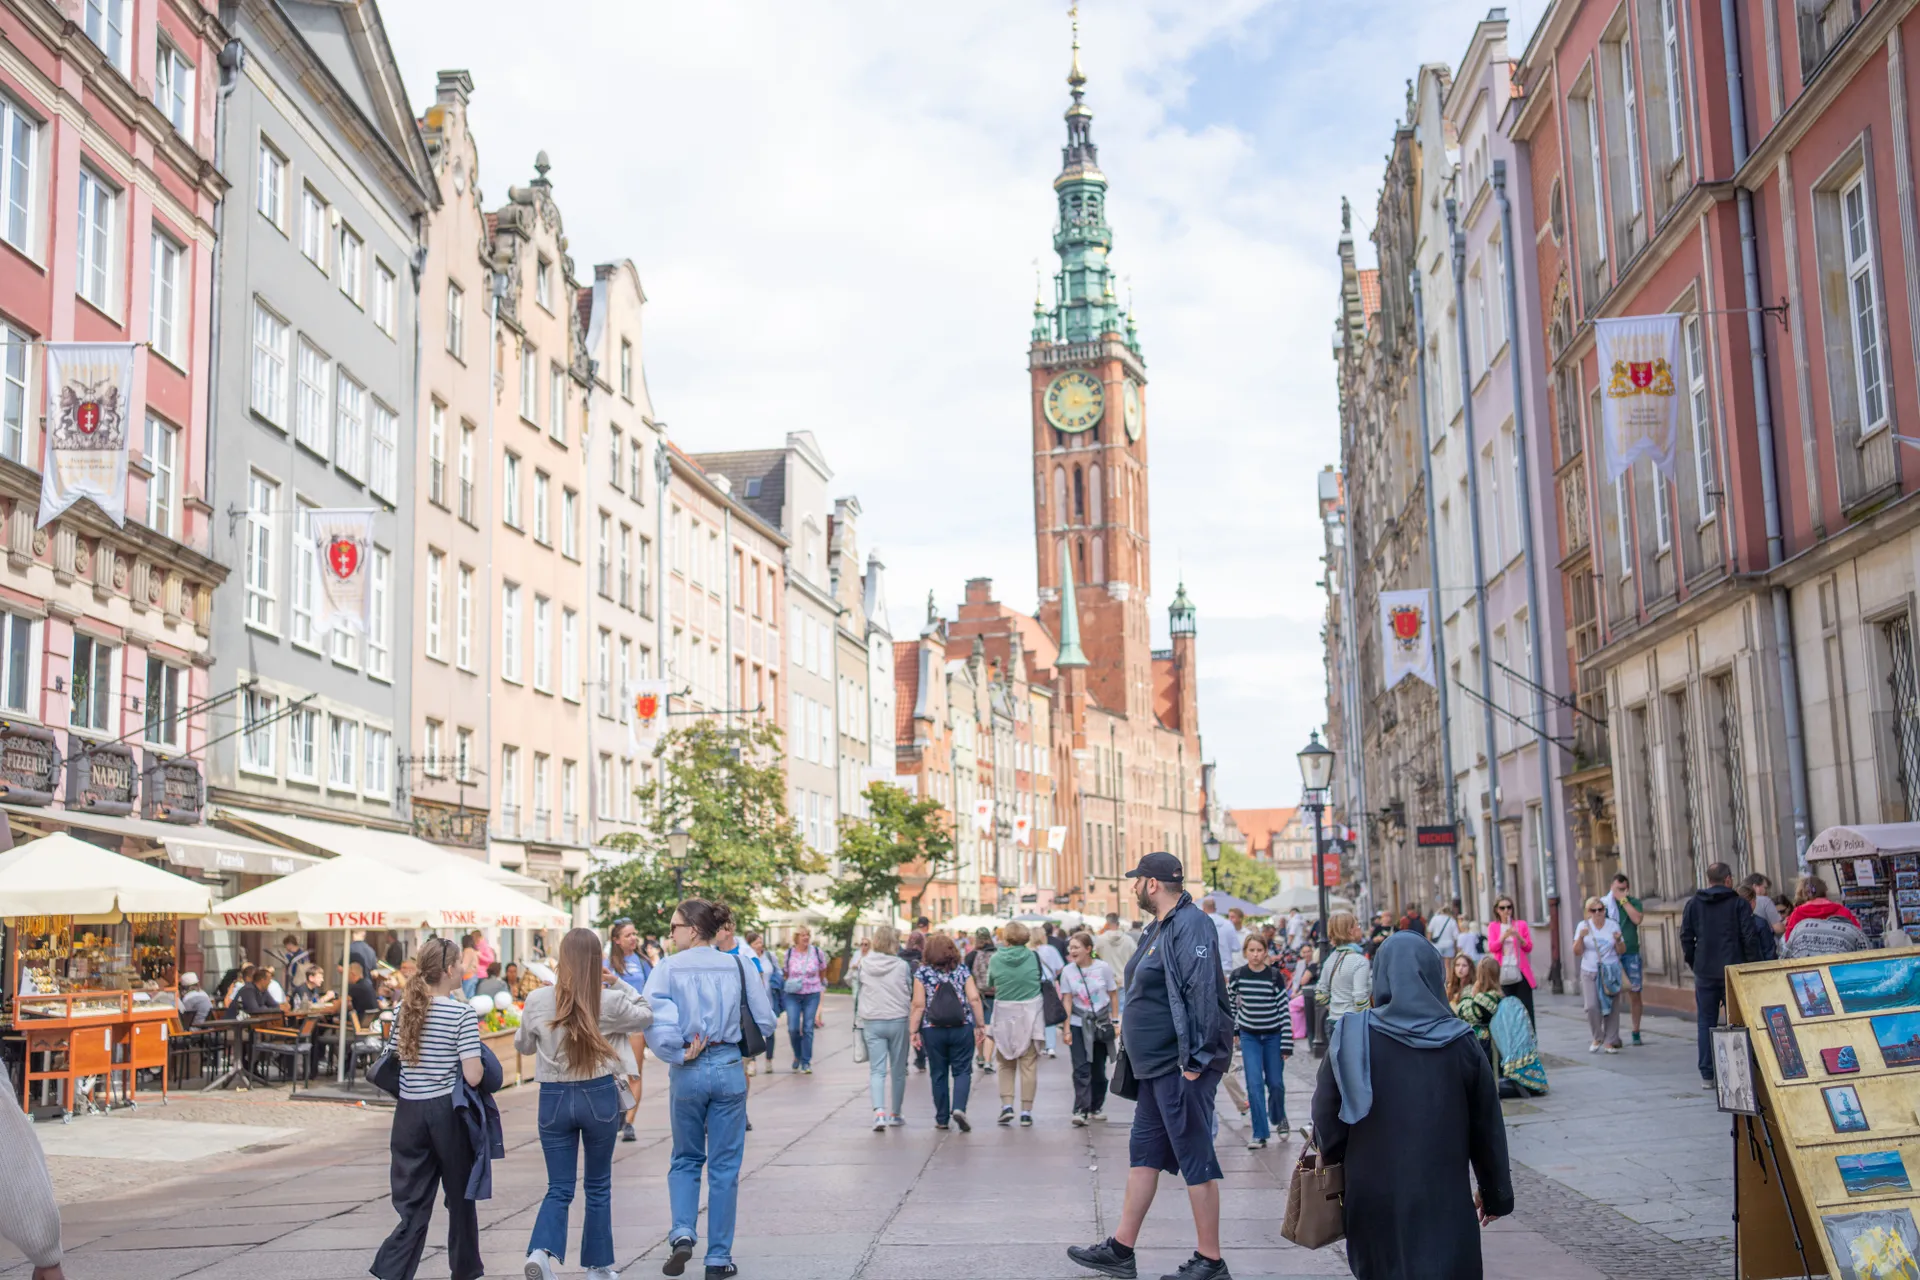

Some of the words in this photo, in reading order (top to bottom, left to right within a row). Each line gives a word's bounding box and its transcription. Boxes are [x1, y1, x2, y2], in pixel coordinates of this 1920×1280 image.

[6, 751, 48, 773] PIZZERIA
[92, 764, 130, 789] NAPOLI
[1811, 844, 1829, 853] Poczta
[1844, 840, 1865, 850] Polska
[221, 911, 272, 926] TYSKIE
[325, 911, 387, 927] TYSKIE
[440, 910, 477, 924] TYSKIE
